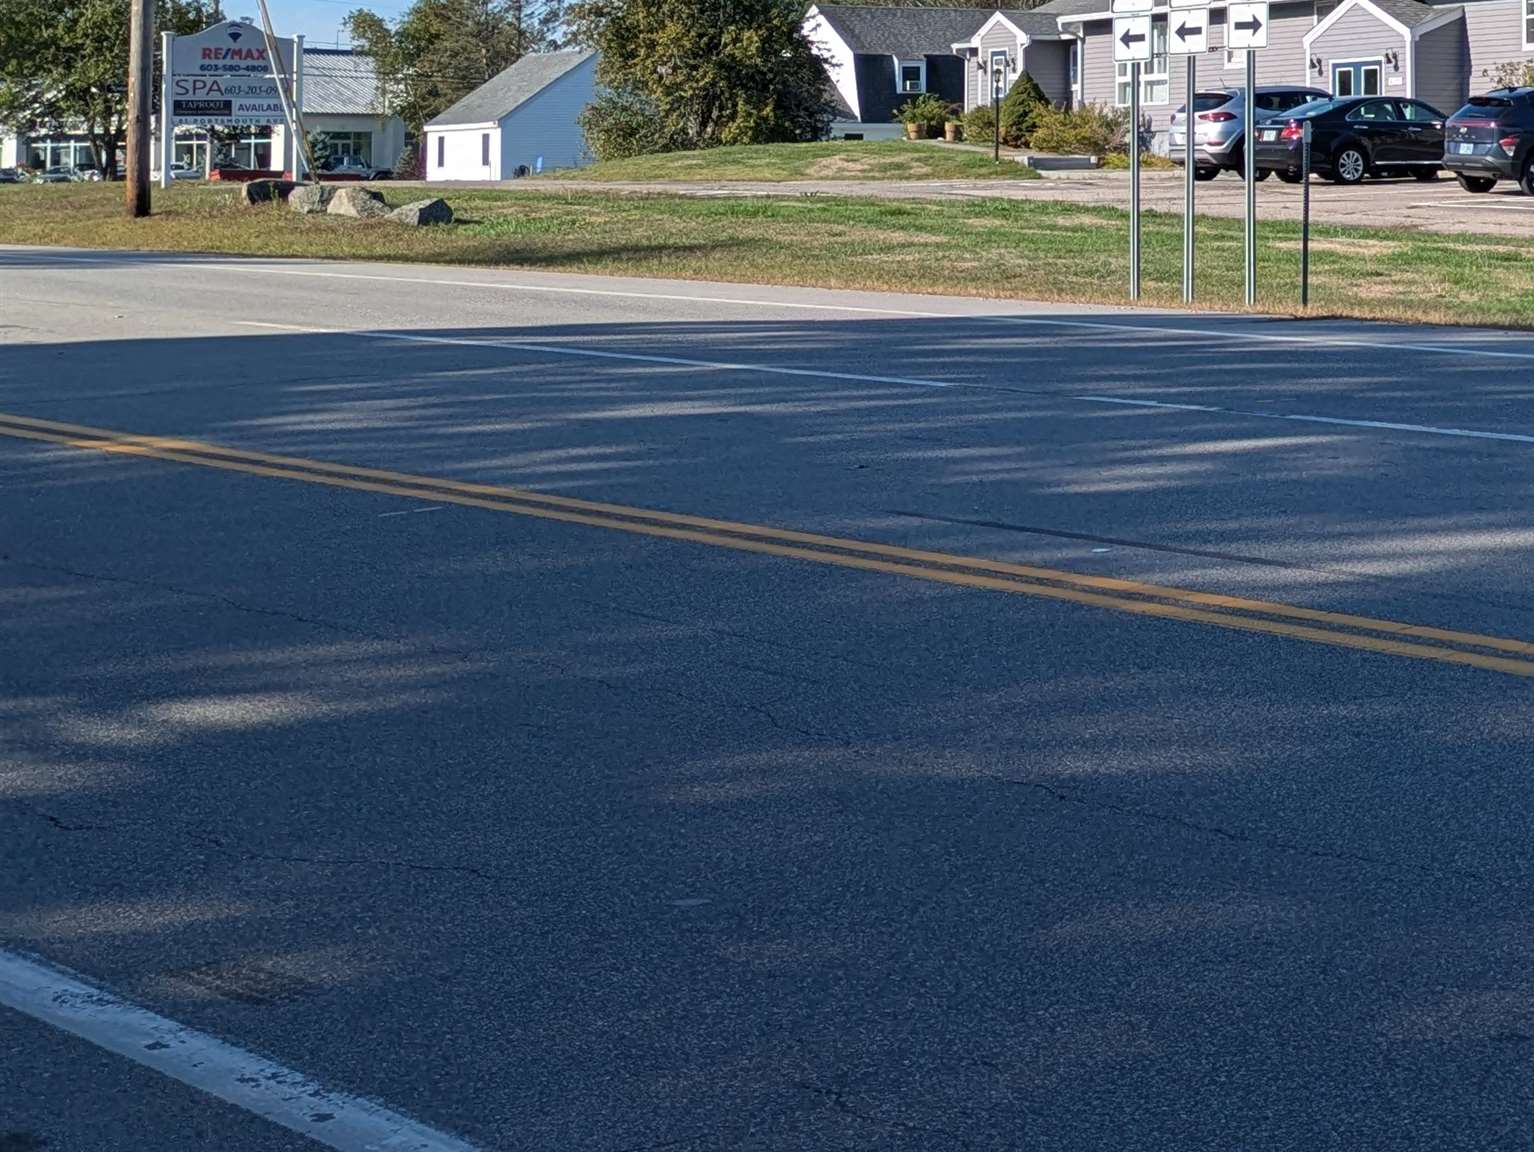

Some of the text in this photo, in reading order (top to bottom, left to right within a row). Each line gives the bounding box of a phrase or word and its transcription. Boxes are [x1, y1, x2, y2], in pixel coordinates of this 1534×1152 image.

[201, 47, 266, 61] RE/MAX
[175, 79, 225, 97] SPA
[237, 103, 285, 113] AVAILABL
